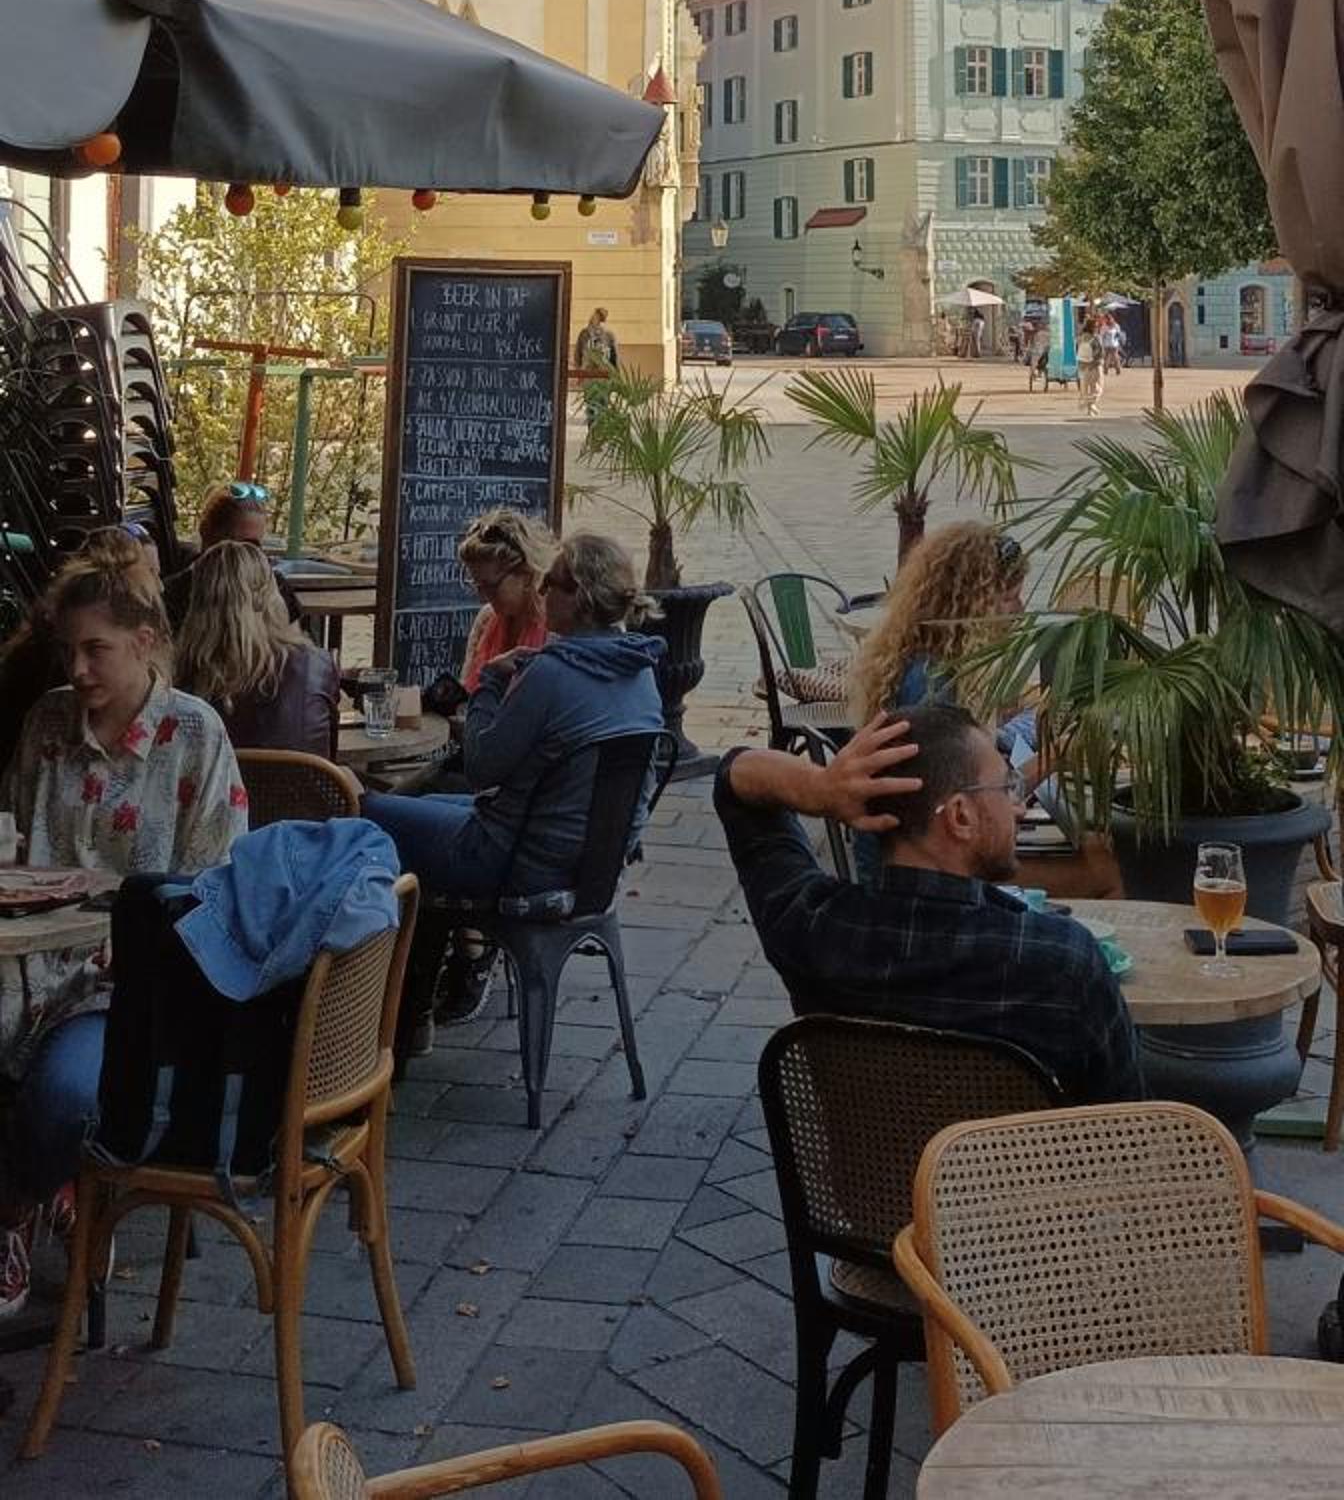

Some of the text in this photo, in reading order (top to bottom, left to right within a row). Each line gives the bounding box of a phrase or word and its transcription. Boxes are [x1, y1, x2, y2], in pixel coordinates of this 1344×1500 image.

[441, 282, 480, 307] BEER
[504, 286, 530, 308] TAP
[415, 481, 467, 507] CATFISH
